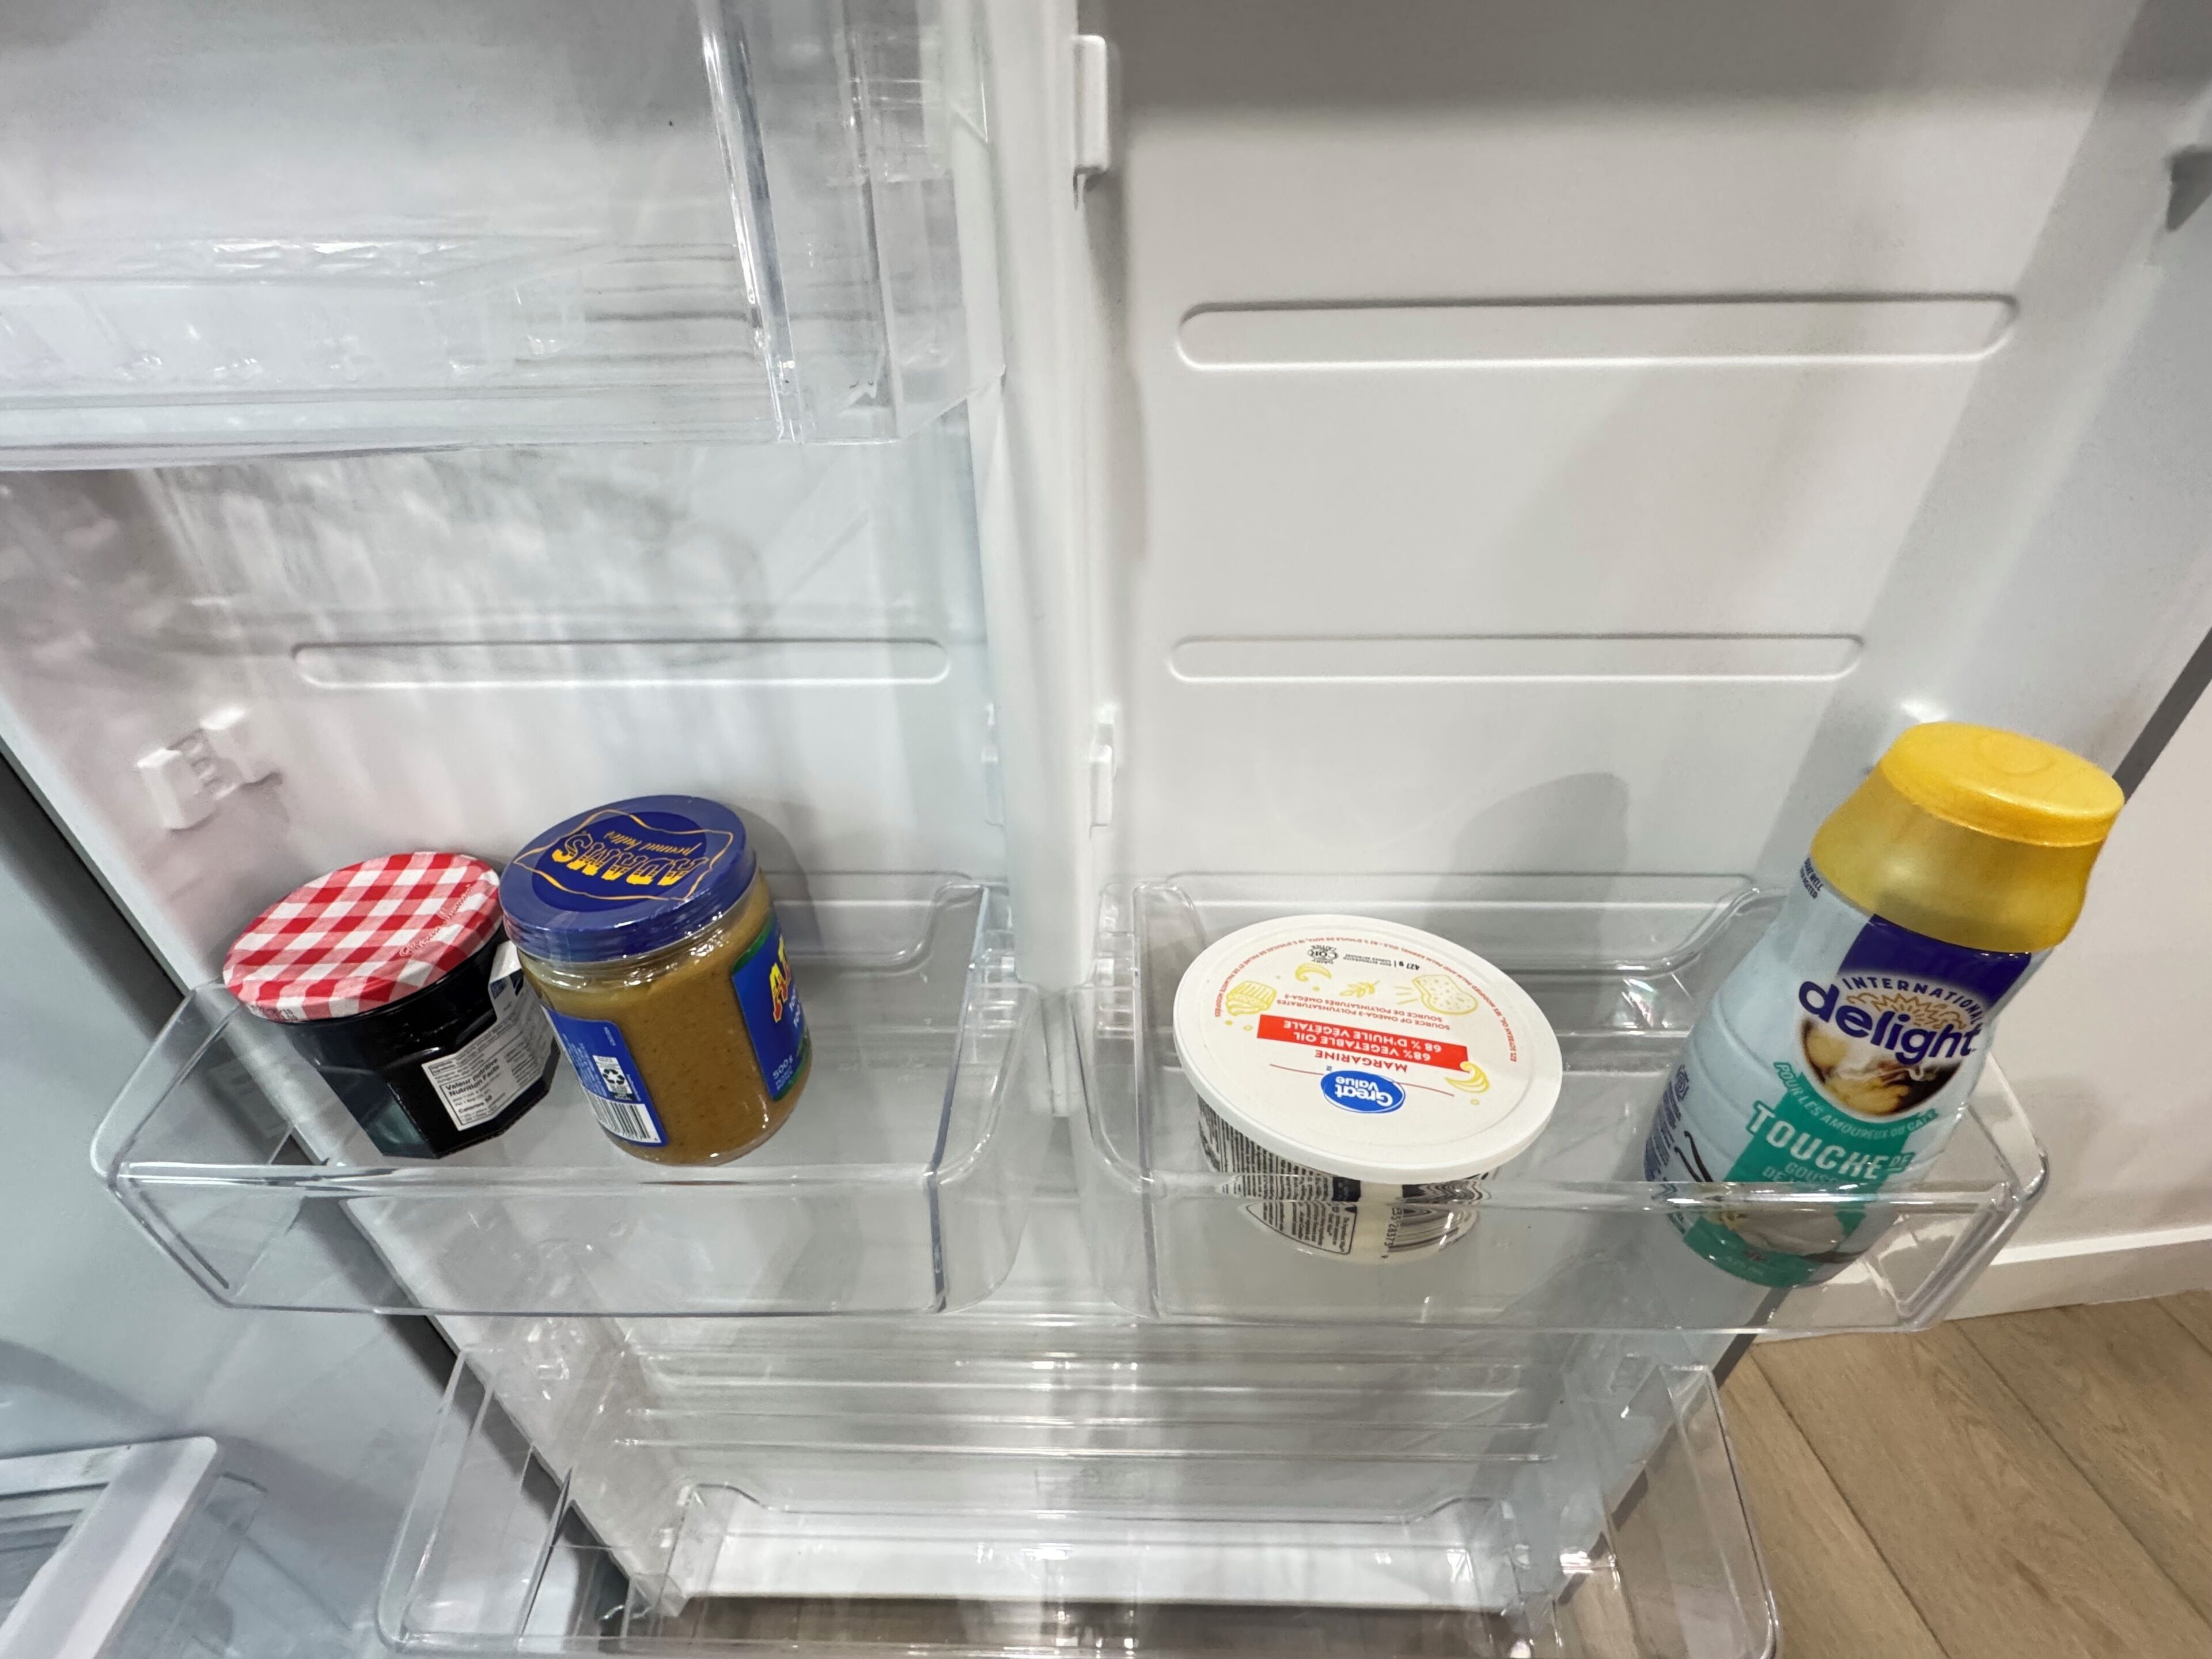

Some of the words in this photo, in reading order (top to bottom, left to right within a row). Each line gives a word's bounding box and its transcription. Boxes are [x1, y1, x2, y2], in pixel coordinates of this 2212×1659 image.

[638, 842, 703, 856] peanut
[551, 834, 709, 886] ADAMS
[1809, 873, 1824, 892] WELL
[1284, 994, 1323, 1003] OMÉGA-3
[1324, 999, 1392, 1014] POLYINSATURÉS
[1843, 976, 1983, 1025] INTERNATIONAL
[1277, 999, 1357, 1016] POLYUNSATURATES
[1358, 1011, 1399, 1022] OMEGA-3
[1407, 1012, 1443, 1022] SOURCE
[1798, 980, 1983, 1066] delight
[1283, 1020, 1350, 1038] VÉGÉTALE
[1414, 1020, 1450, 1031] SOURCE
[1293, 1032, 1317, 1043] OIL
[1319, 1035, 1400, 1057] VEGETABLE
[1353, 1031, 1408, 1047] D'HUILE
[1411, 1040, 1422, 1050] %
[1402, 1049, 1431, 1062] 68%
[1424, 1043, 1442, 1053] 68
[772, 1059, 789, 1080] 500
[1315, 1049, 1408, 1074] MARGARINE
[445, 1078, 471, 1091] Valeur
[449, 1079, 483, 1097] Nutrition
[1335, 1076, 1379, 1092] Value
[1335, 1083, 1394, 1107] Great
[1776, 1063, 1804, 1096] POUR
[1799, 1095, 1824, 1116] LES
[1820, 1113, 1888, 1140] AMOUREUX
[1749, 1103, 1889, 1180] TOUCHE
[1888, 1155, 1910, 1168] DE
[1761, 1165, 1786, 1182] DE
